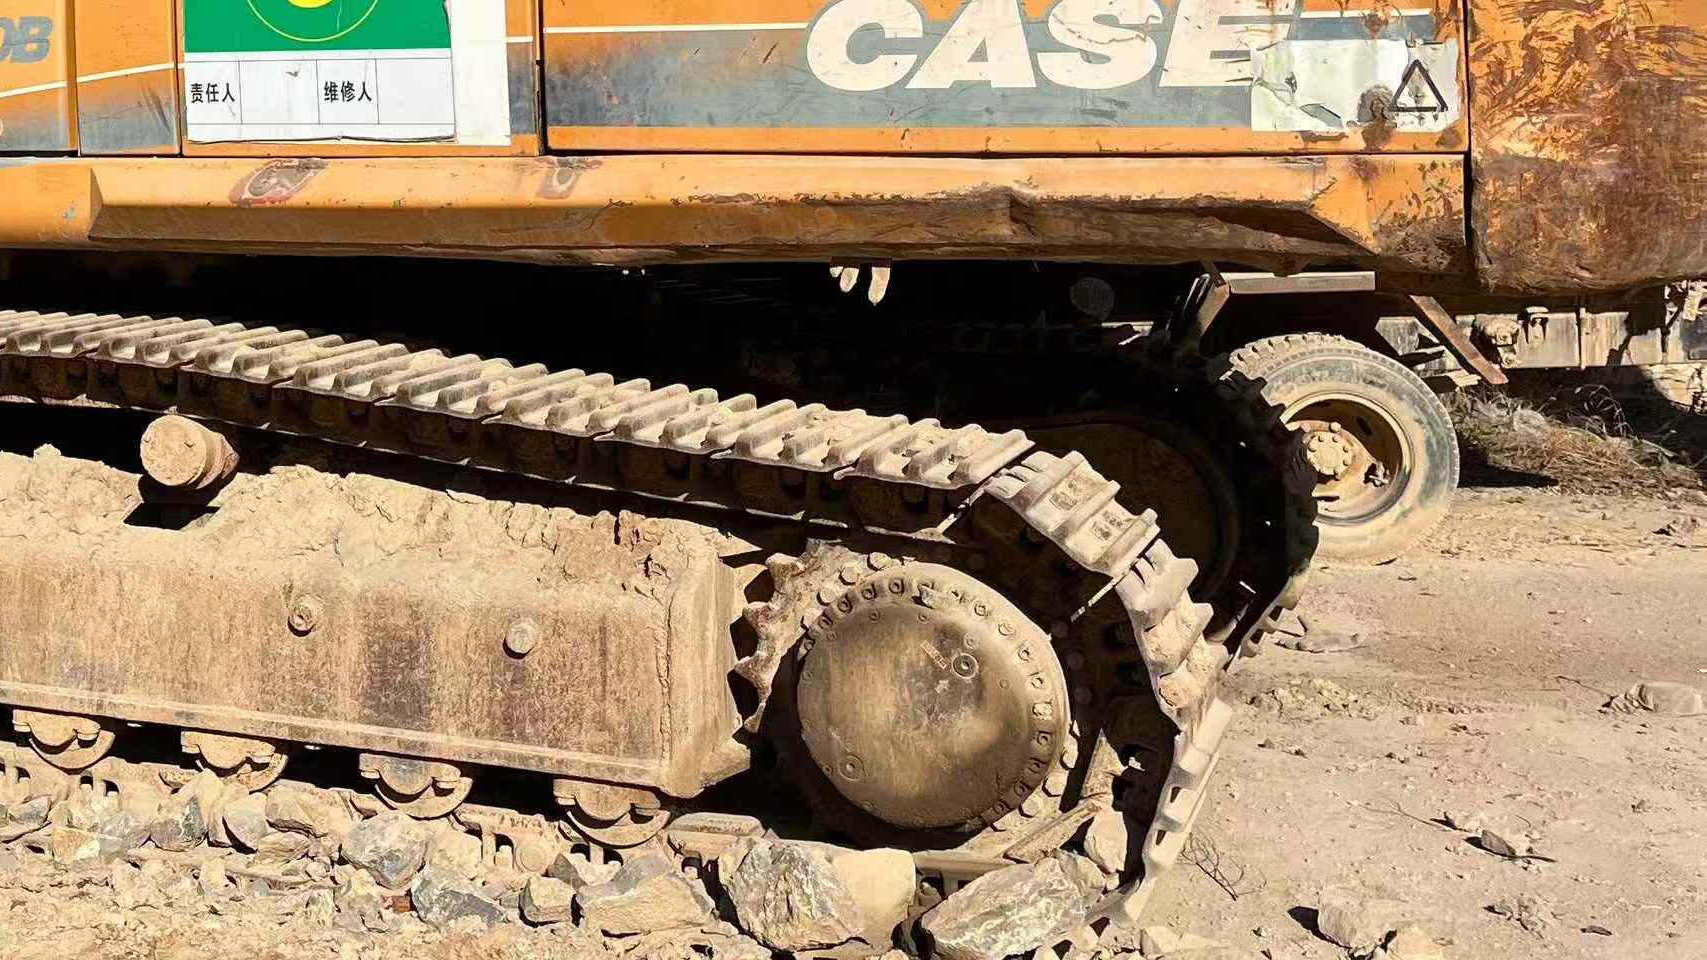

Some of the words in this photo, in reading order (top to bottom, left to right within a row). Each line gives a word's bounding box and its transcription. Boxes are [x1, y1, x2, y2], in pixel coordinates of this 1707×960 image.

[190, 82, 236, 103] 责任人
[323, 80, 372, 103] 维修人
